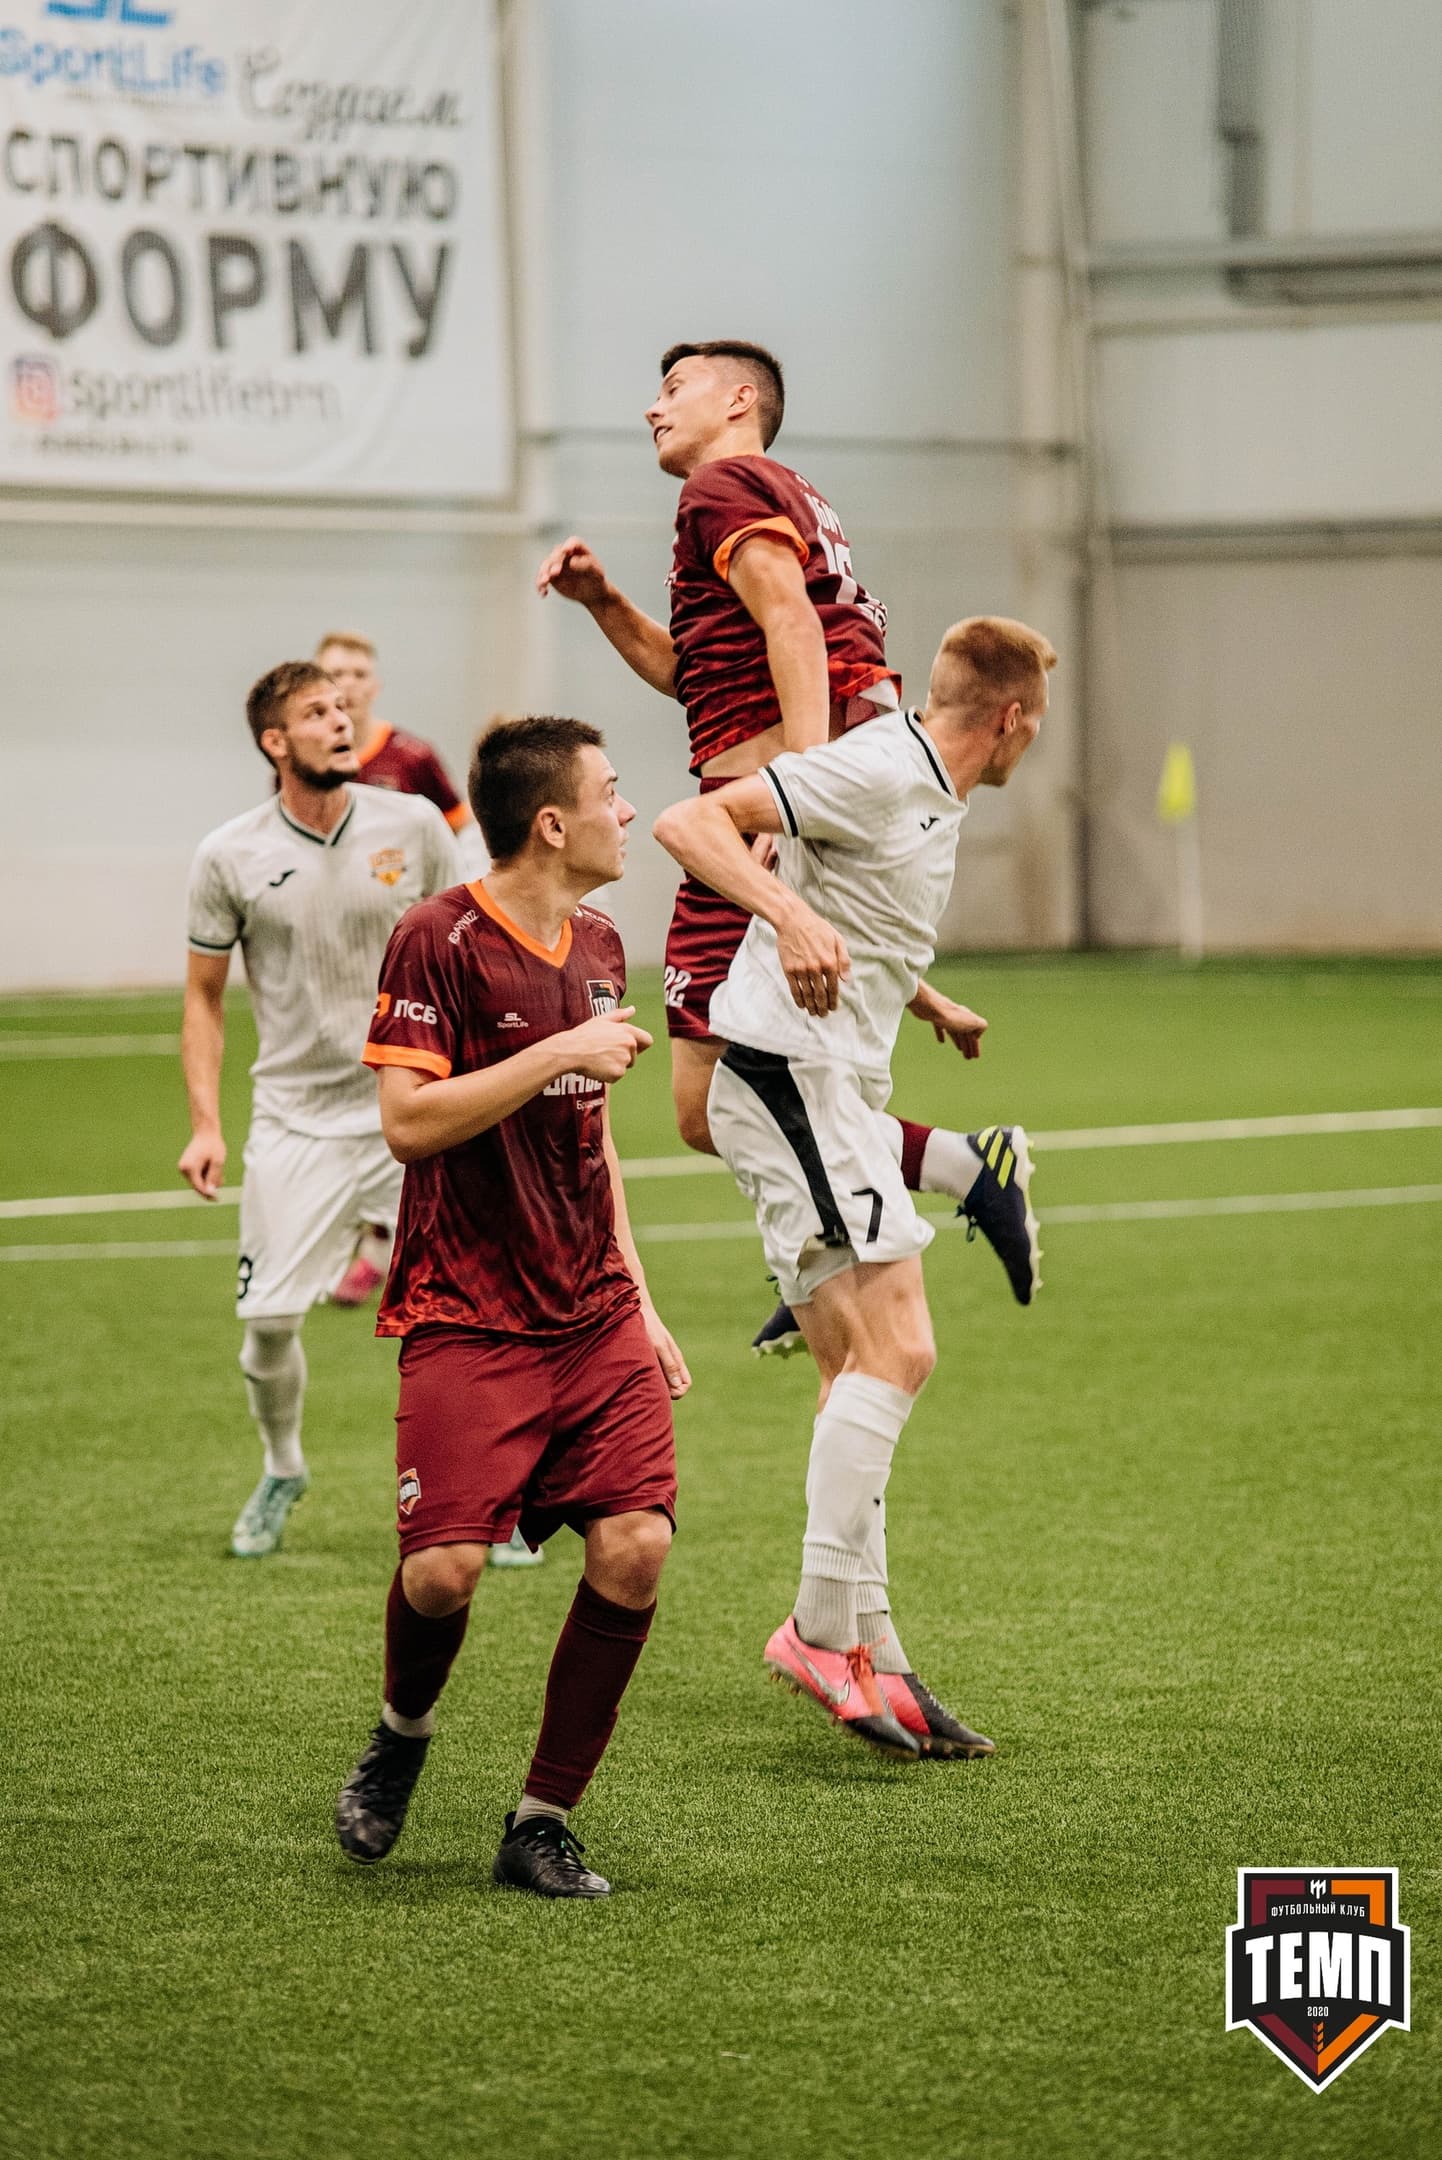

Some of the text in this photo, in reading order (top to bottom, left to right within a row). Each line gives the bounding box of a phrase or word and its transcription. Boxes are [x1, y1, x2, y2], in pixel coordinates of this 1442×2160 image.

[6, 129, 460, 220] СПОРТИВНУЮ
[10, 222, 454, 358] ФОРМУ
[394, 999, 438, 1025] ПСБ
[851, 1188, 884, 1243] 7
